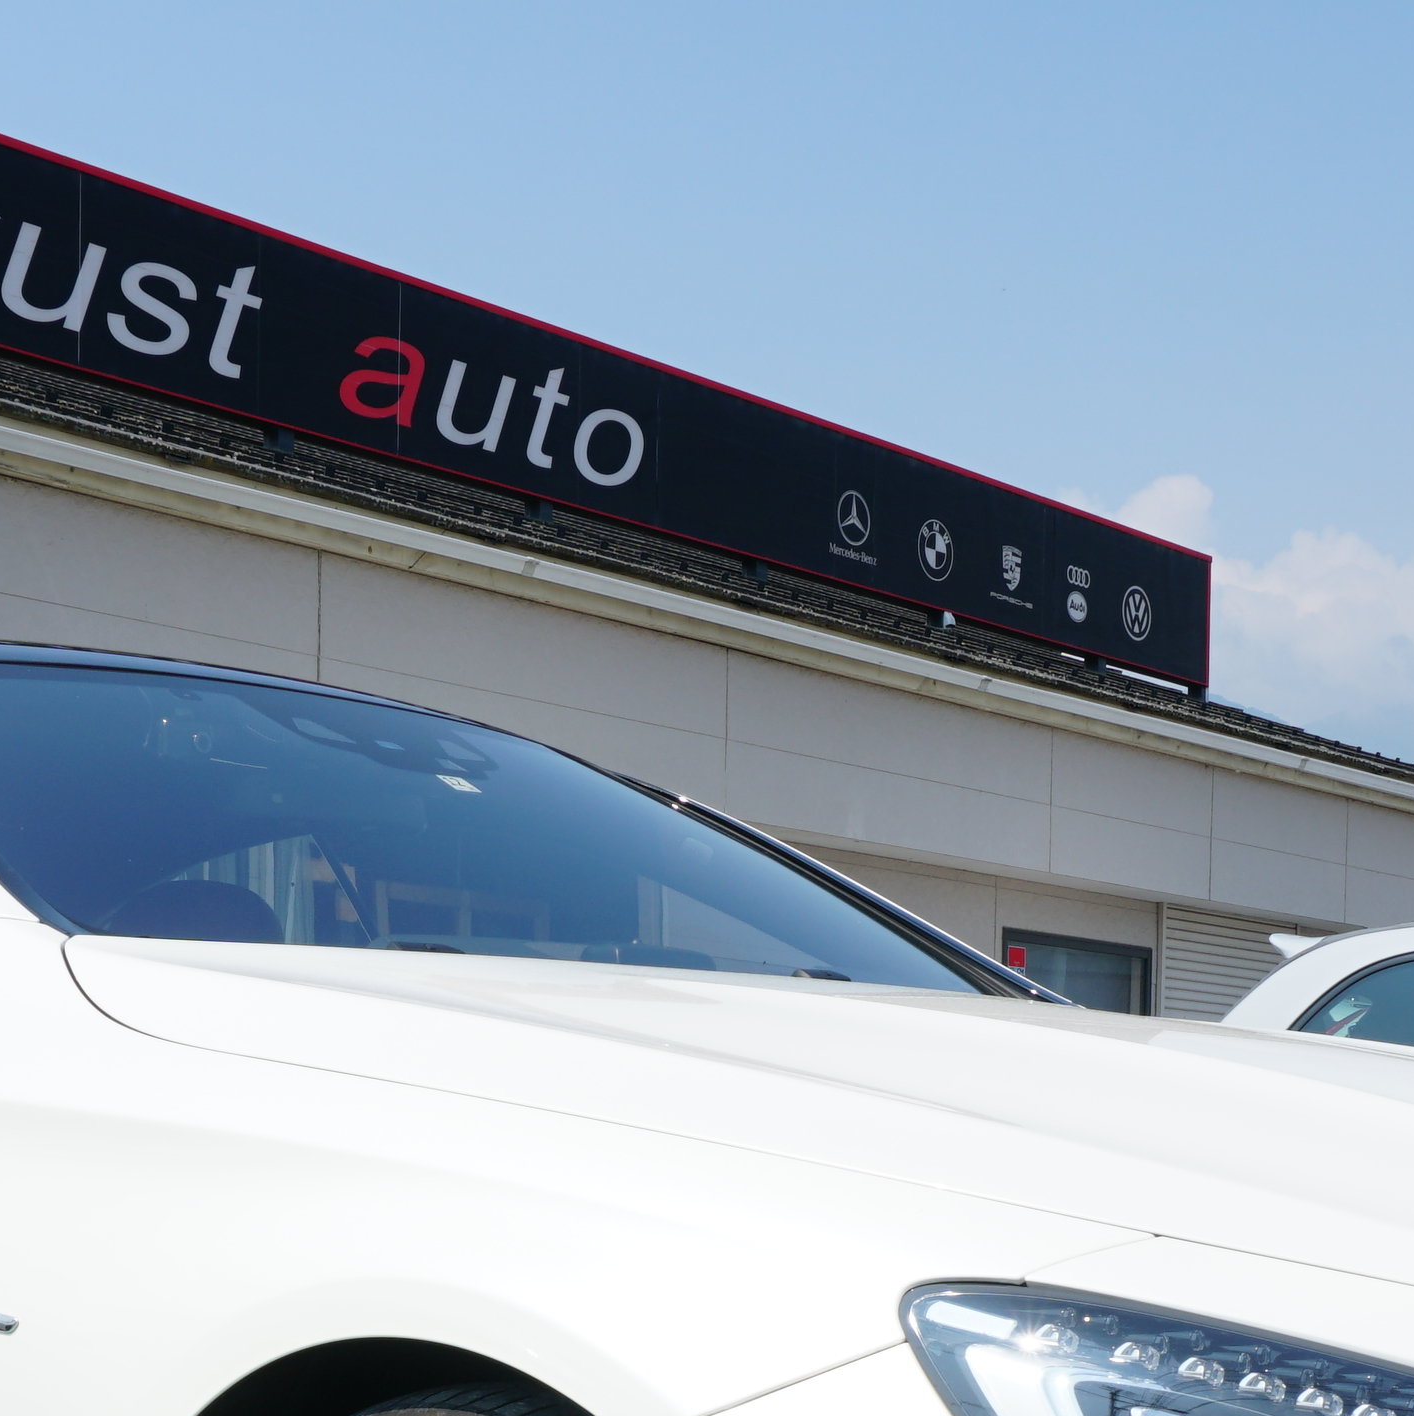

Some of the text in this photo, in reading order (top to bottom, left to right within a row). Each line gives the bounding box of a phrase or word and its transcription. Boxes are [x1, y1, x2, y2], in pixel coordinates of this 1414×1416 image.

[339, 334, 645, 487] auto
[828, 542, 878, 566] Mercedes-Benz
[989, 591, 1033, 610] PORSCHE
[1069, 599, 1086, 614] Audi
